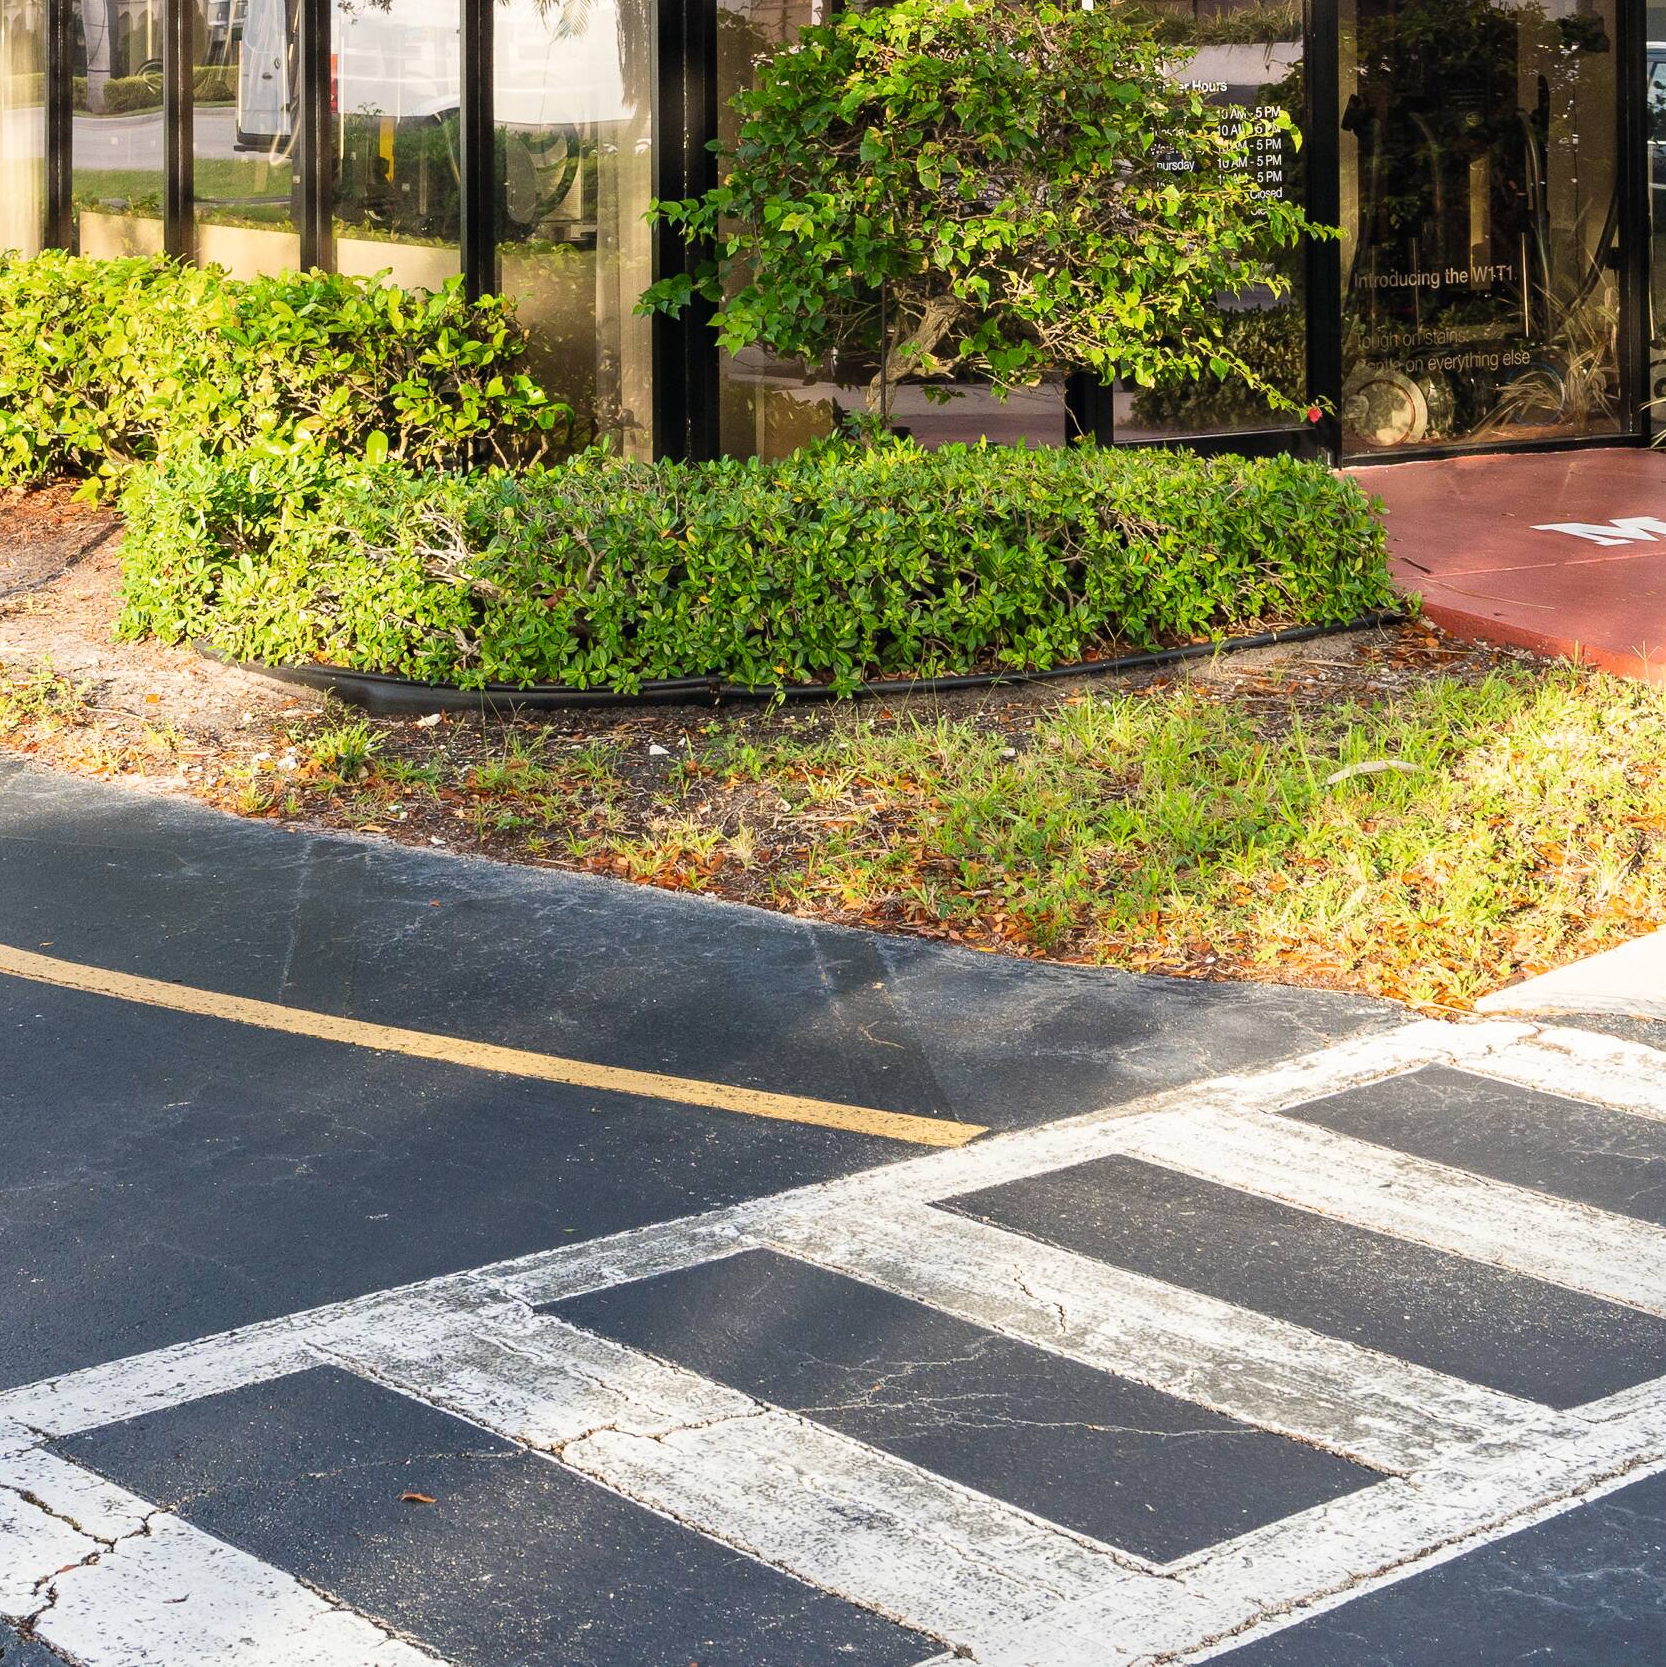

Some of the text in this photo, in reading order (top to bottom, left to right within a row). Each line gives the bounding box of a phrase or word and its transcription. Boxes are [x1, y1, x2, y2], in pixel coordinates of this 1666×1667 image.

[1192, 80, 1228, 93] Hours
[1255, 107, 1263, 118] 5
[1265, 105, 1281, 118] PM
[1216, 124, 1229, 136] 10
[1256, 139, 1264, 150] 5
[1265, 138, 1282, 150] PM
[1256, 155, 1264, 167] 5
[1265, 154, 1282, 166] PM
[1257, 171, 1264, 183] 5
[1266, 170, 1282, 183] PM
[1250, 186, 1283, 200] Closed
[1354, 269, 1440, 289] Introducing
[1445, 267, 1469, 285] the
[1402, 333, 1421, 347] on
[1406, 358, 1424, 373] on
[1427, 351, 1499, 373] everything
[1502, 349, 1531, 367] else
